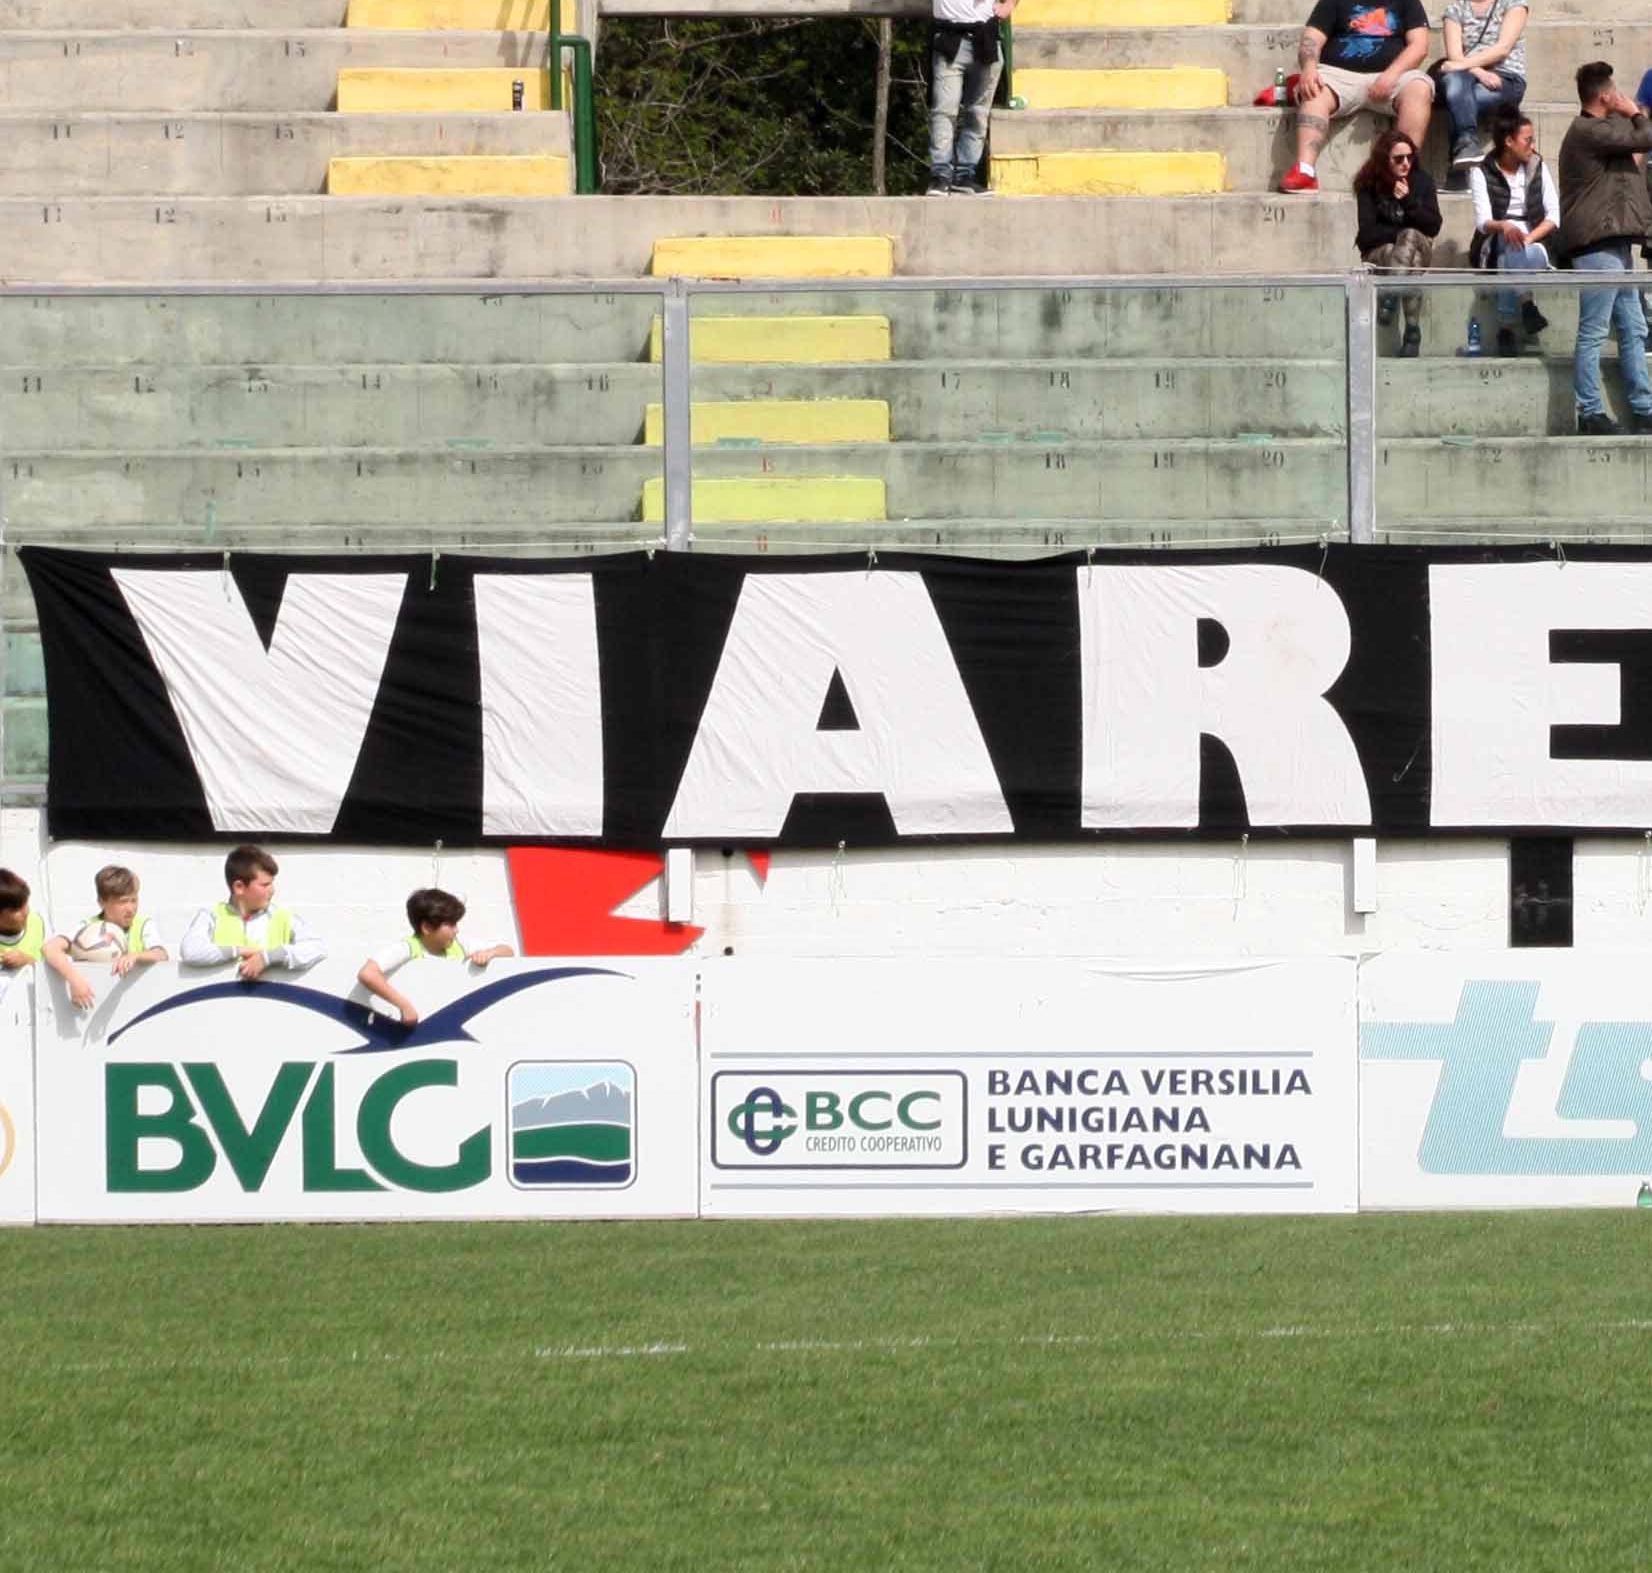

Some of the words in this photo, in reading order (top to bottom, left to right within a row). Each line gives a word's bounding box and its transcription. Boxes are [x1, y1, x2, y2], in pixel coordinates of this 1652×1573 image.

[1262, 206, 1286, 224] 20
[1047, 371, 1071, 388] 18
[1262, 371, 1286, 389] 20
[1043, 453, 1066, 470] 18
[1261, 450, 1285, 467] 20
[987, 1069, 1130, 1096] BANCA
[1142, 1069, 1312, 1096] VERSILIA
[805, 1090, 942, 1131] BCC
[105, 1058, 491, 1193] BVLG
[987, 1107, 1211, 1134] LUNIGIANA
[805, 1136, 856, 1153] CREDITO
[860, 1136, 942, 1153] COOPERATIVO
[987, 1143, 1006, 1170] E
[1020, 1143, 1303, 1171] GARFAGNANA
